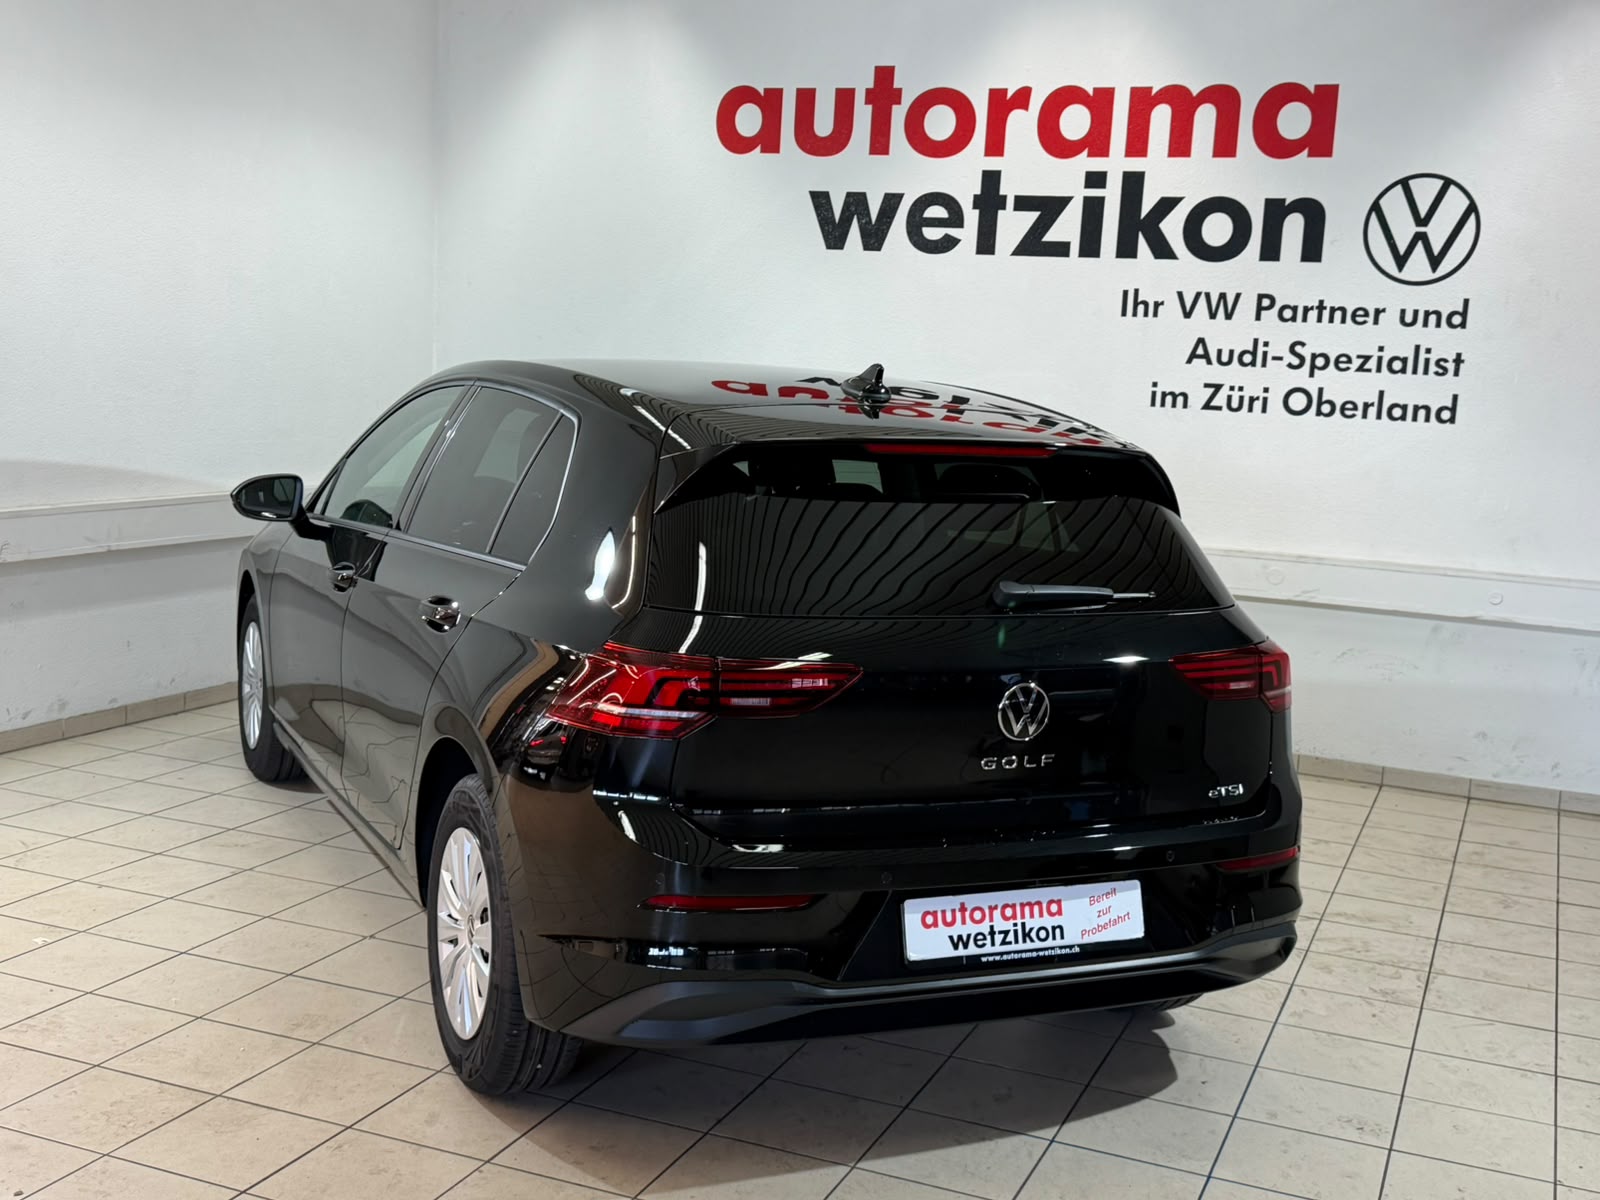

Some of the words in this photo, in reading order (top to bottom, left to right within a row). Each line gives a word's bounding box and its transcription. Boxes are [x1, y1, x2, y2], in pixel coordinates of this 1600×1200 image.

[717, 66, 1339, 159] autorama
[809, 170, 1326, 262] wetzikon
[1121, 289, 1165, 318] Ihr
[1177, 291, 1241, 321] VW
[1255, 294, 1386, 326] Partner
[1399, 299, 1470, 330] und
[1186, 338, 1465, 377] Audi-Spezialist
[1150, 382, 1189, 409] im
[1200, 383, 1270, 414] Züri
[1282, 388, 1459, 424] Oberland
[980, 753, 1056, 770] GOLF
[1208, 783, 1244, 799] eTSI
[1089, 887, 1117, 906] Bereit
[1096, 905, 1112, 918] zur
[920, 898, 1063, 930] autorama
[1081, 911, 1131, 940] Probefahrt
[947, 922, 1065, 951] wetzikon
